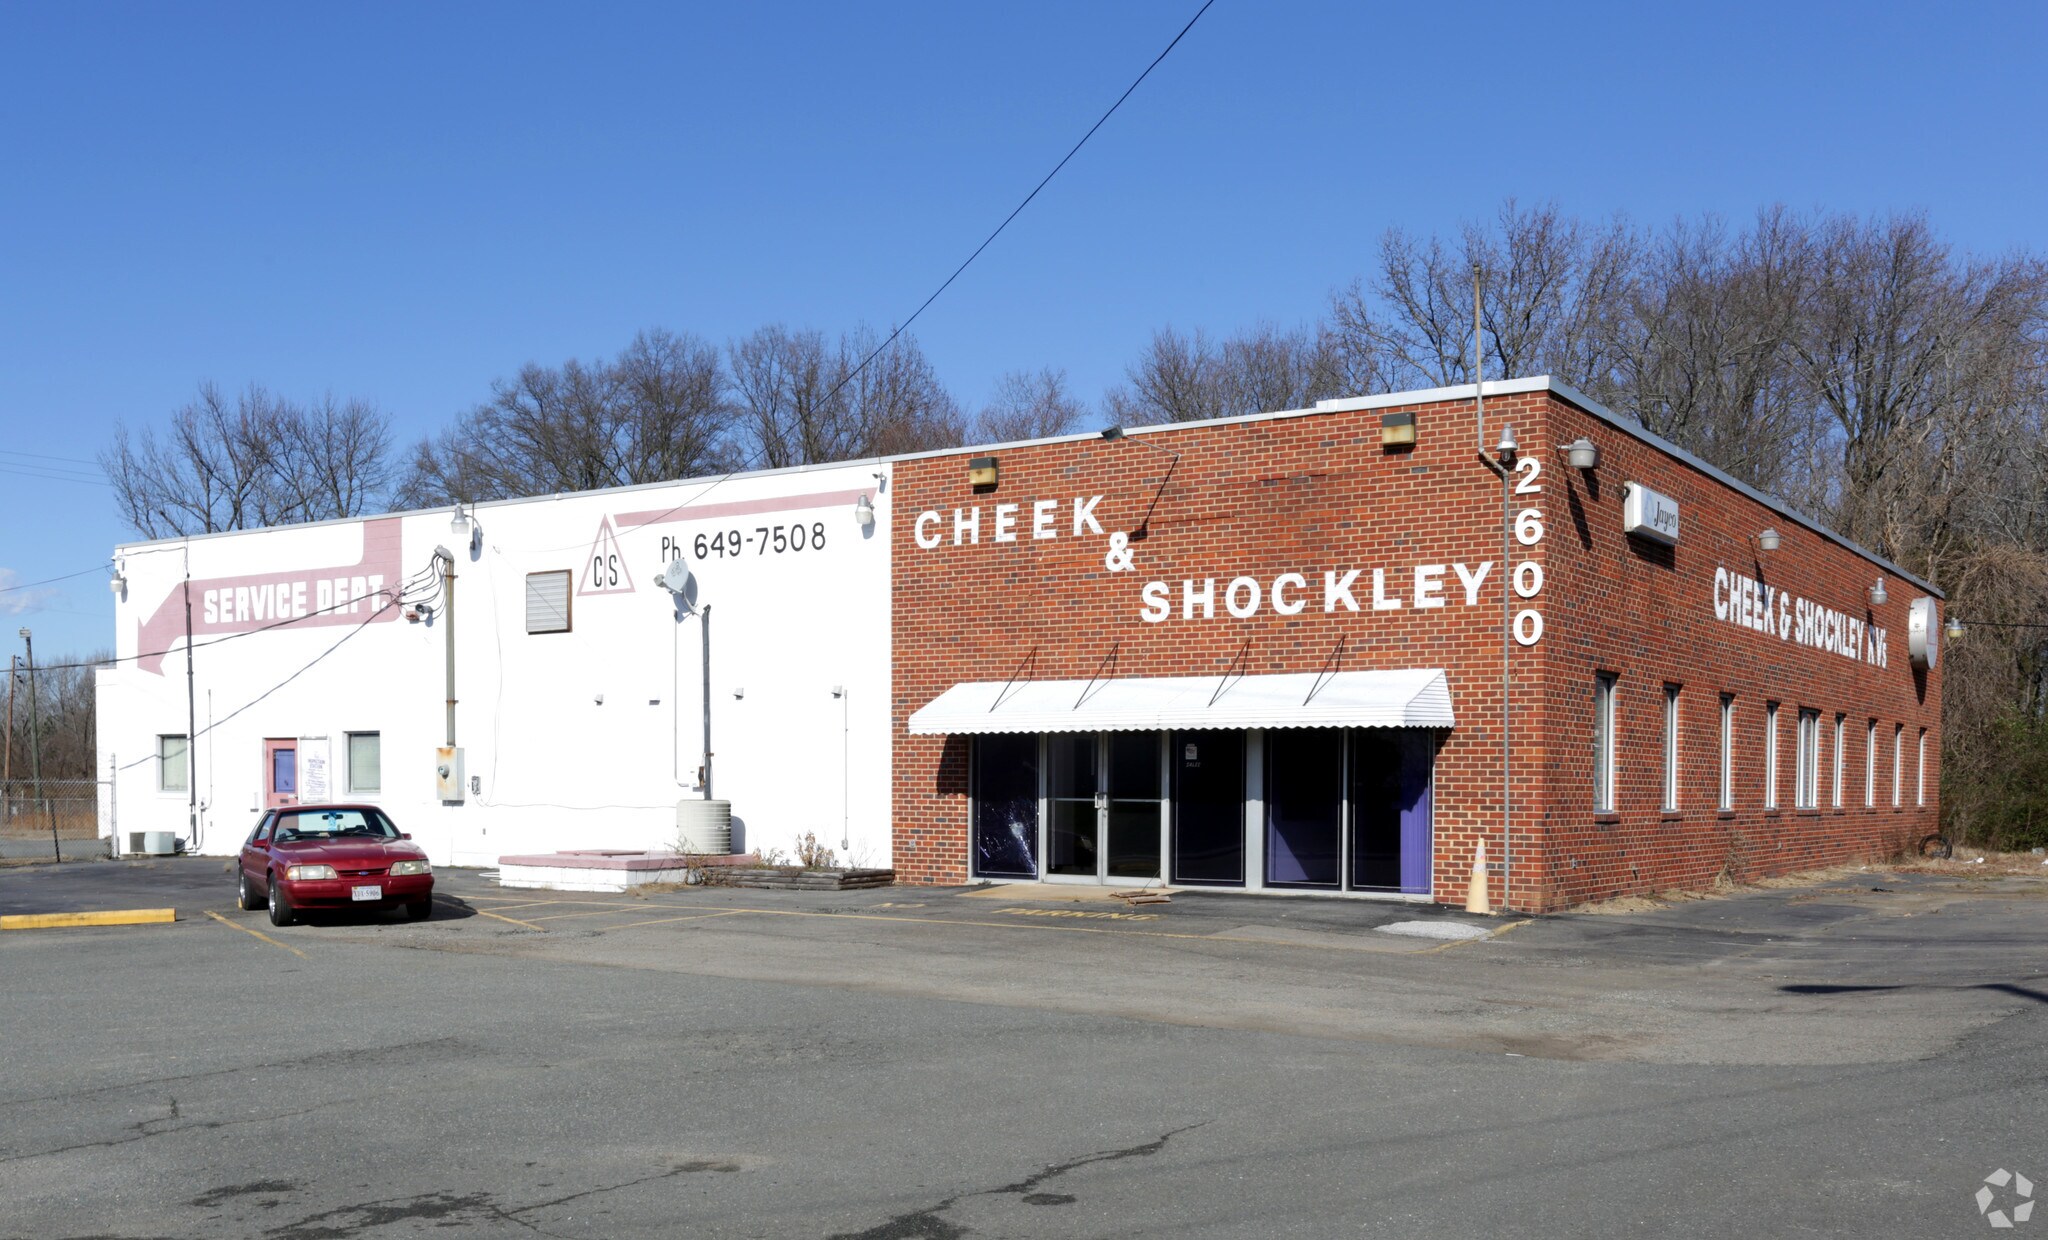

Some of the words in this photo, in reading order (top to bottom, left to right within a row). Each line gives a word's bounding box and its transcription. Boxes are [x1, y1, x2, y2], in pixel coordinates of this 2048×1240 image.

[914, 493, 1106, 551] CHEEK
[1653, 501, 1677, 532] Jayco
[694, 522, 826, 560] 649-7508
[1105, 531, 1137, 573] &
[1512, 456, 1545, 647] 2600
[203, 581, 308, 625] SERVICE
[1139, 561, 1495, 624] SHOCKLEY
[1713, 566, 1776, 636] CHEEK
[1779, 591, 1792, 641] &
[1794, 597, 1866, 661] SHOCKLEY
[991, 907, 1164, 921] PARKING
